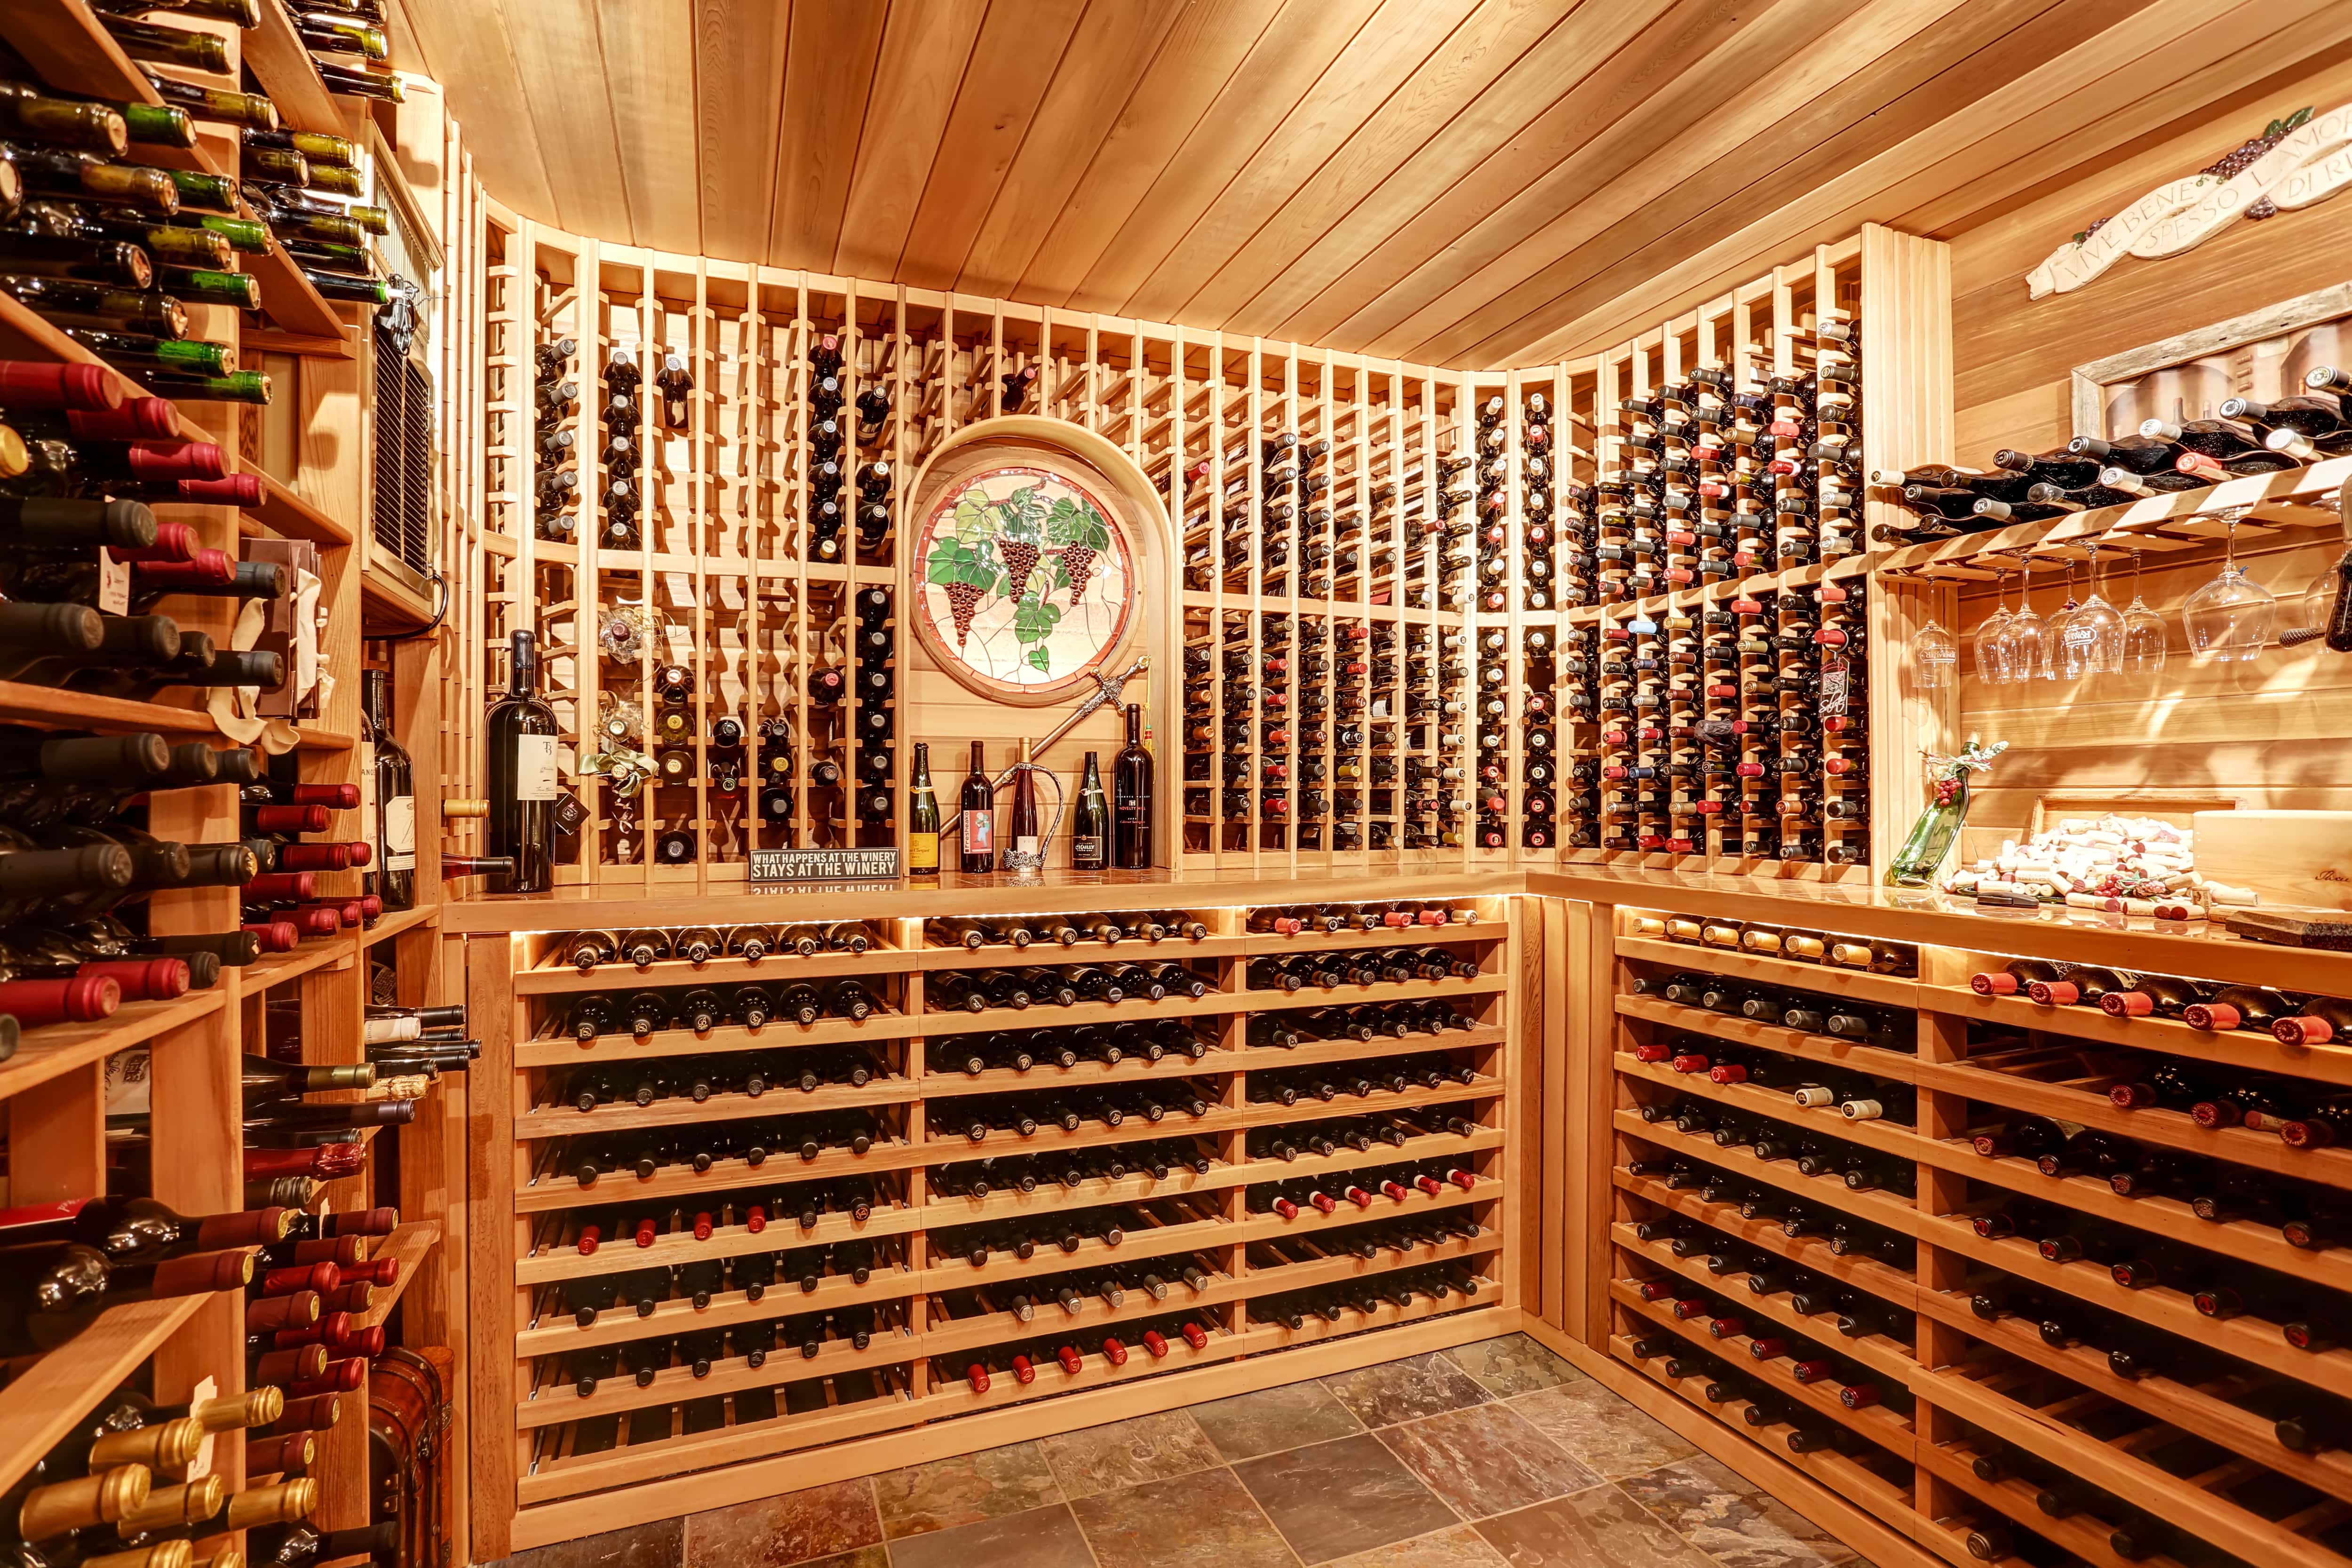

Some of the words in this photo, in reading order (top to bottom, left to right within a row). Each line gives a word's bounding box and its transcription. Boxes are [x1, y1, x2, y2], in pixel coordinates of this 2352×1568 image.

[2289, 173, 2312, 198] DI
[2065, 229, 2120, 278] VIVE
[2122, 183, 2193, 232] BENE
[2146, 189, 2239, 249] SPESSO
[753, 854, 780, 864] WHAT
[782, 853, 826, 863] HAPPENS
[829, 852, 840, 862] AT
[842, 852, 859, 862] THE
[860, 852, 896, 862] WINERY
[753, 864, 795, 877] STAYS
[797, 863, 813, 876] AT
[817, 862, 842, 876] THE
[845, 861, 895, 875] WINERY
